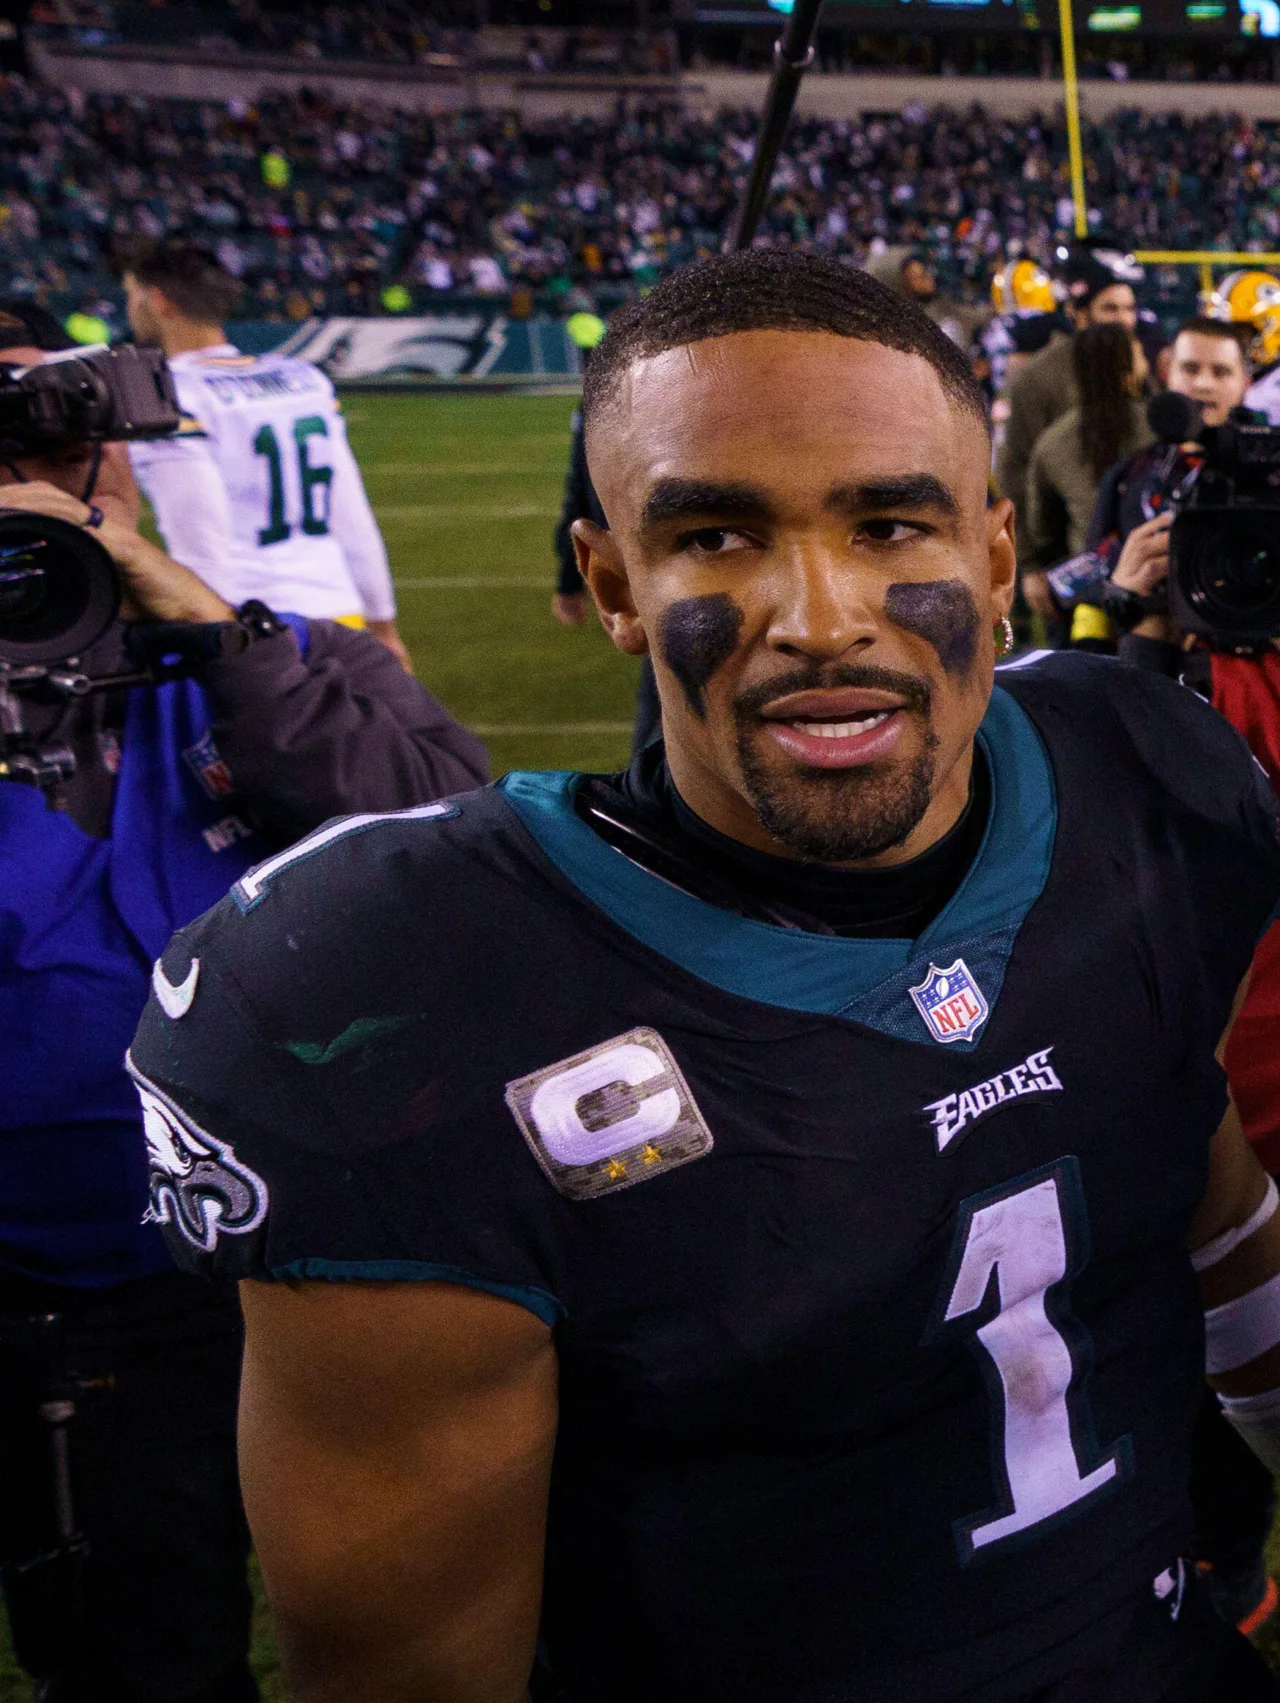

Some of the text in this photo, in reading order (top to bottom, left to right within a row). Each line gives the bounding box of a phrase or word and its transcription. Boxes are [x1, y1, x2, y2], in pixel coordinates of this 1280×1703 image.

[253, 415, 333, 547] 16
[932, 992, 981, 1034] NFL
[529, 1042, 683, 1167] C
[922, 1046, 1064, 1153] EAGLES
[939, 1172, 1123, 1554] 1
